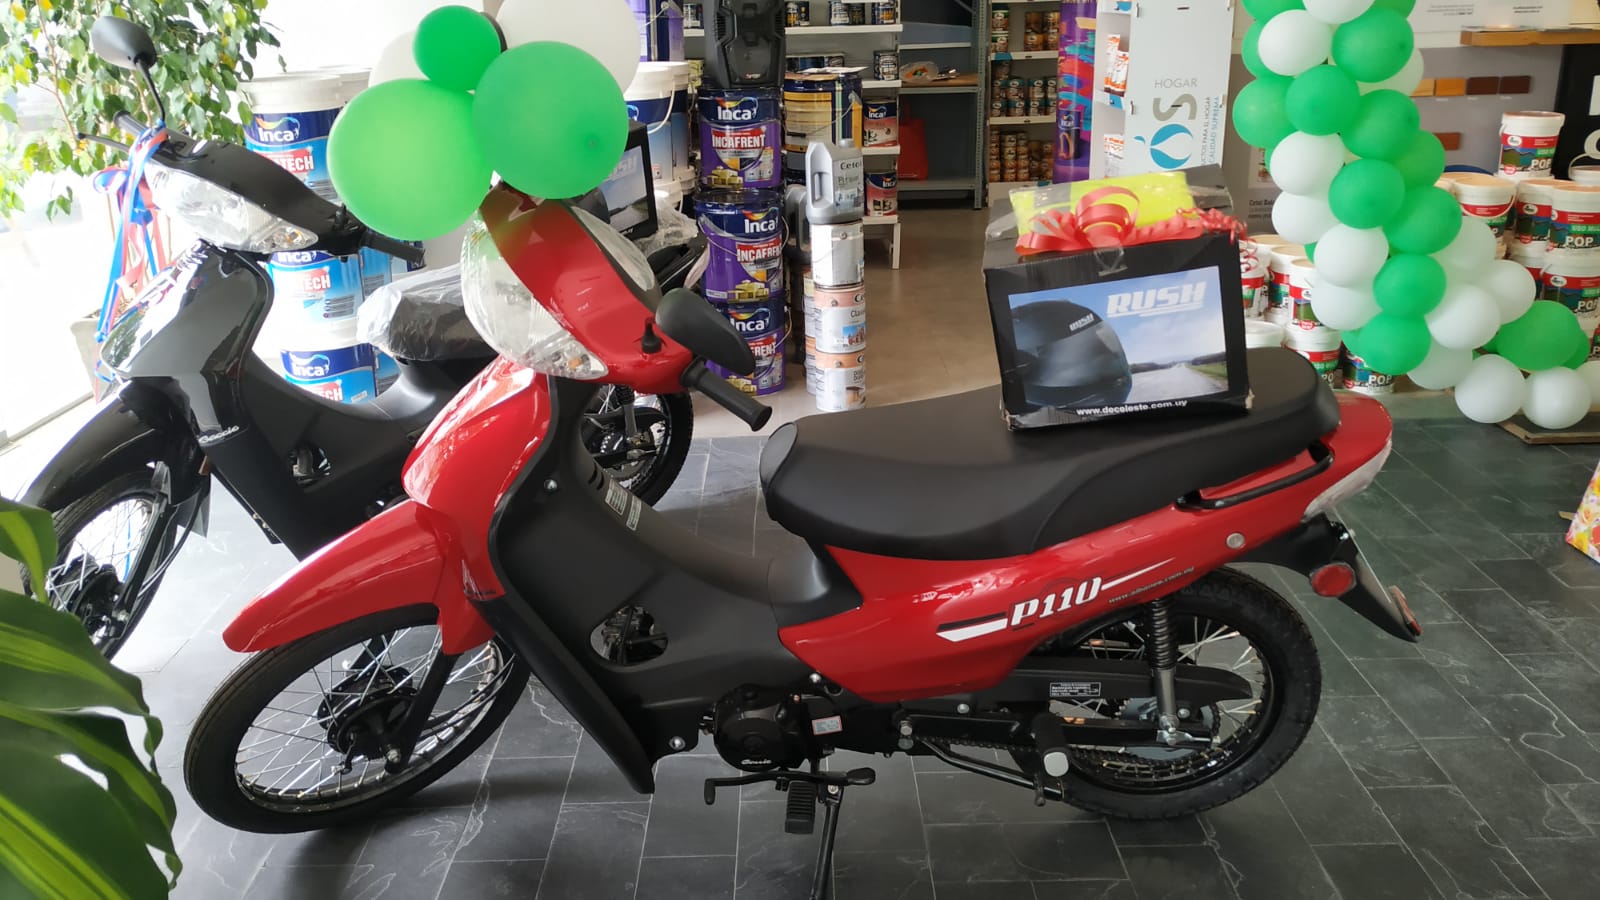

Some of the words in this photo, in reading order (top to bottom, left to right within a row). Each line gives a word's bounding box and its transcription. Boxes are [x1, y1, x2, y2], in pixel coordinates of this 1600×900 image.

[1154, 78, 1198, 89] HOGAR
[717, 106, 753, 120] Inca
[868, 106, 884, 118] Inca
[1203, 96, 1211, 120] HOGAR
[1211, 96, 1220, 130] SUPREMA
[258, 127, 295, 142] Inca
[712, 134, 765, 148] INCAFRENT
[1208, 131, 1217, 163] CALIDAD
[743, 218, 776, 233] Inca
[1565, 235, 1594, 247] POP
[1107, 281, 1207, 316] RUSH
[1368, 374, 1392, 385] POP
[1011, 576, 1102, 627] P110
